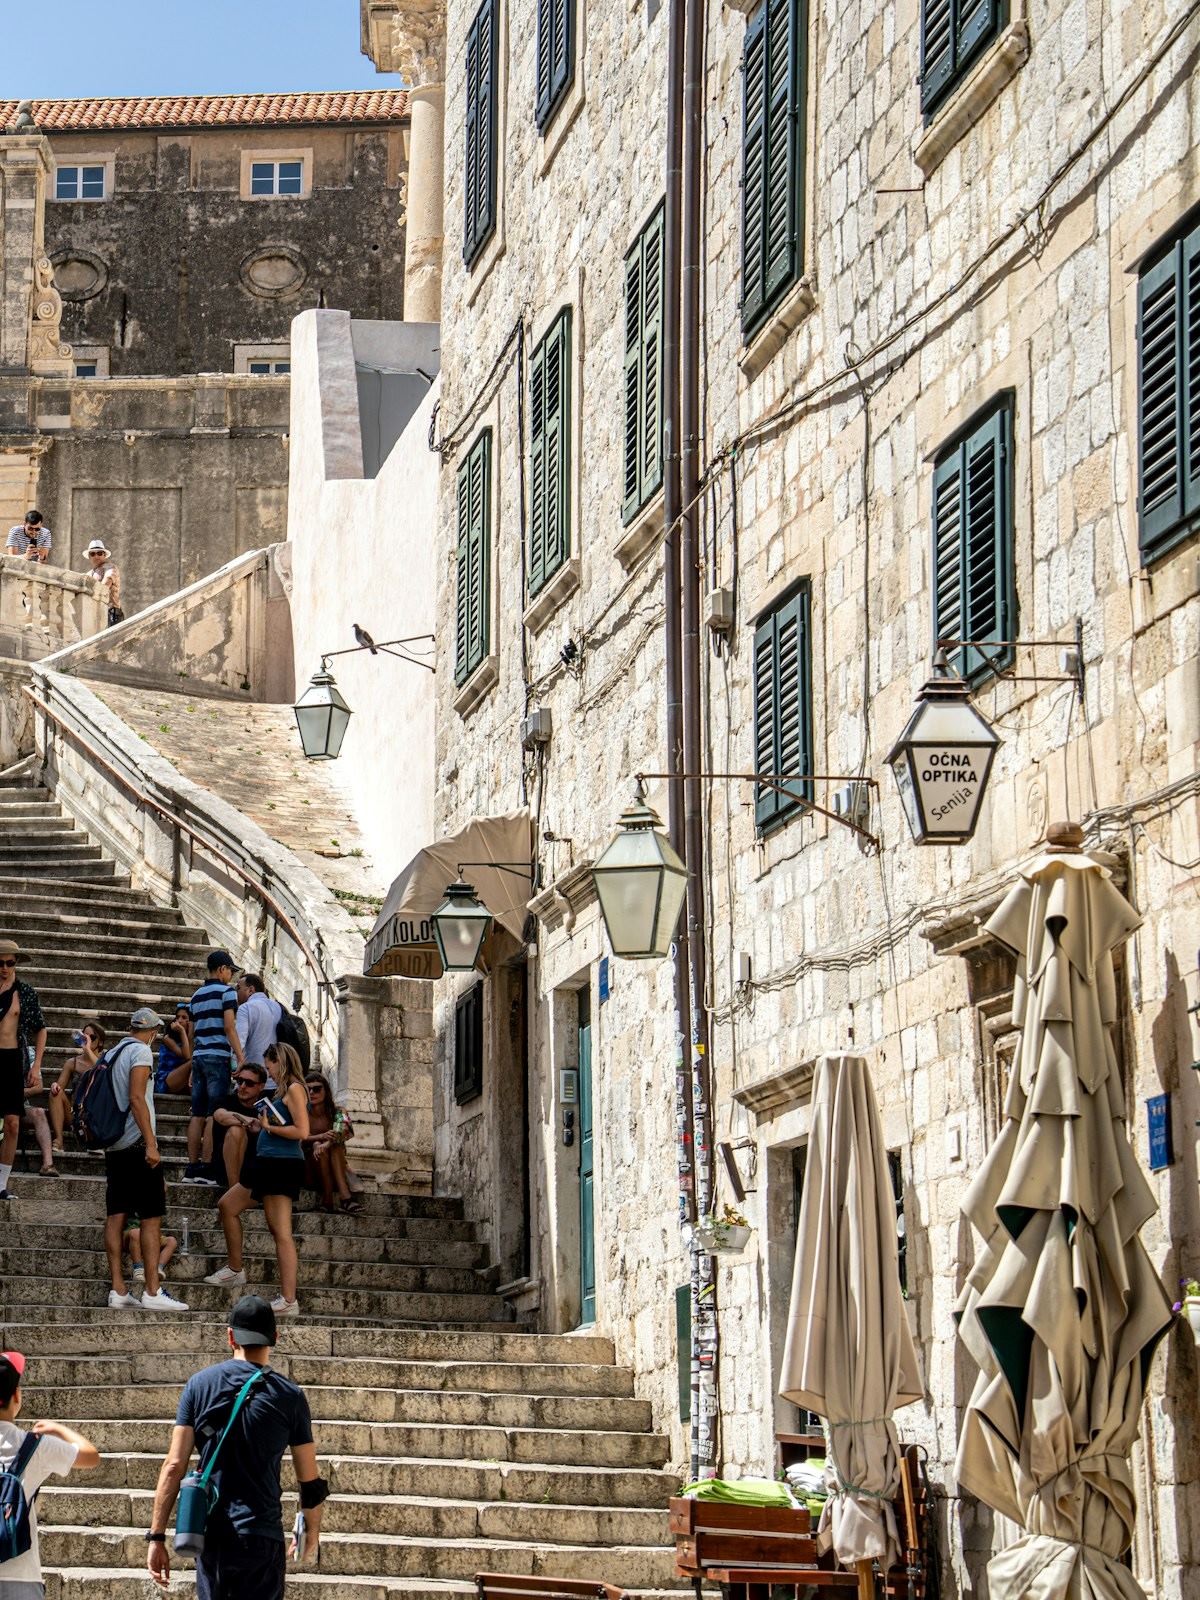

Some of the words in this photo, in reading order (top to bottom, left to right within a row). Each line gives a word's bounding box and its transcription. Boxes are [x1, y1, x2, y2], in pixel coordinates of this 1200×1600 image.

[930, 752, 971, 766] OČNA
[922, 770, 978, 783] OPTIKA
[931, 787, 973, 821] Senija
